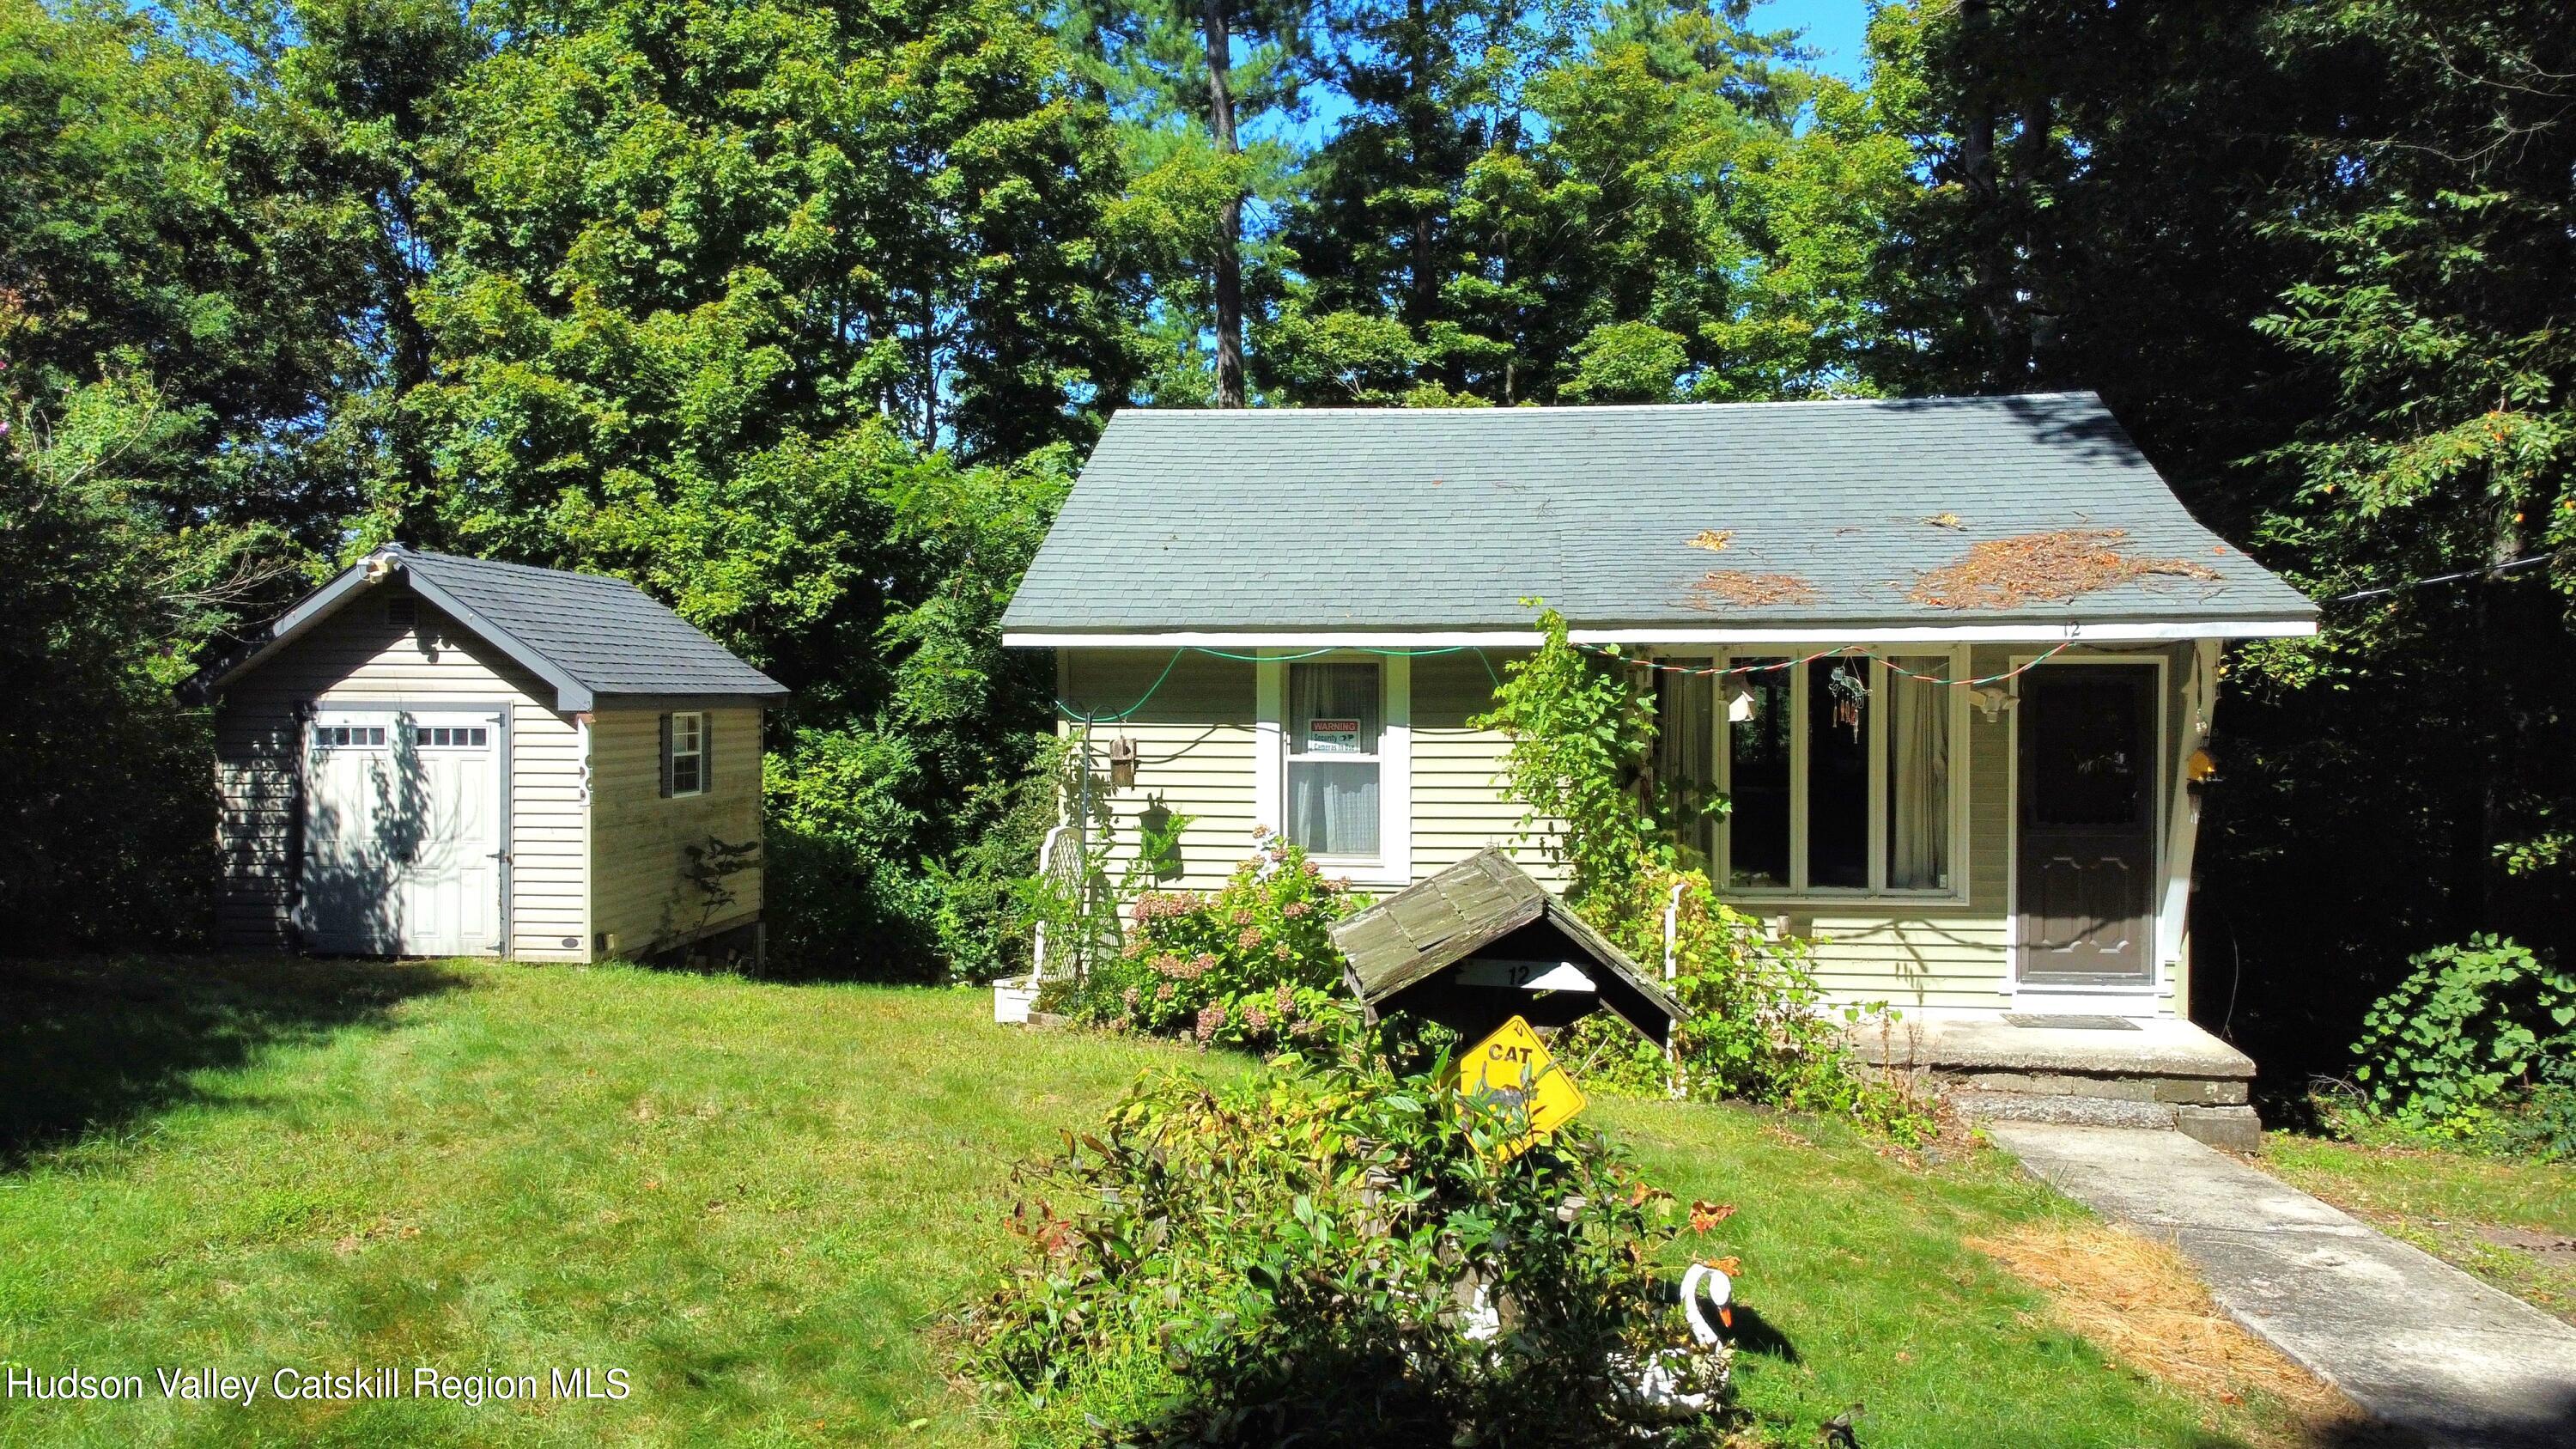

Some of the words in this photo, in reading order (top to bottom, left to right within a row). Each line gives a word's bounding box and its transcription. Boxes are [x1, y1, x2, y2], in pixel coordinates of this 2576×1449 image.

[2064, 621, 2081, 637] 12
[1314, 734, 1337, 743] Security
[1509, 965, 1529, 985] 12
[1488, 1044, 1533, 1064] CAT
